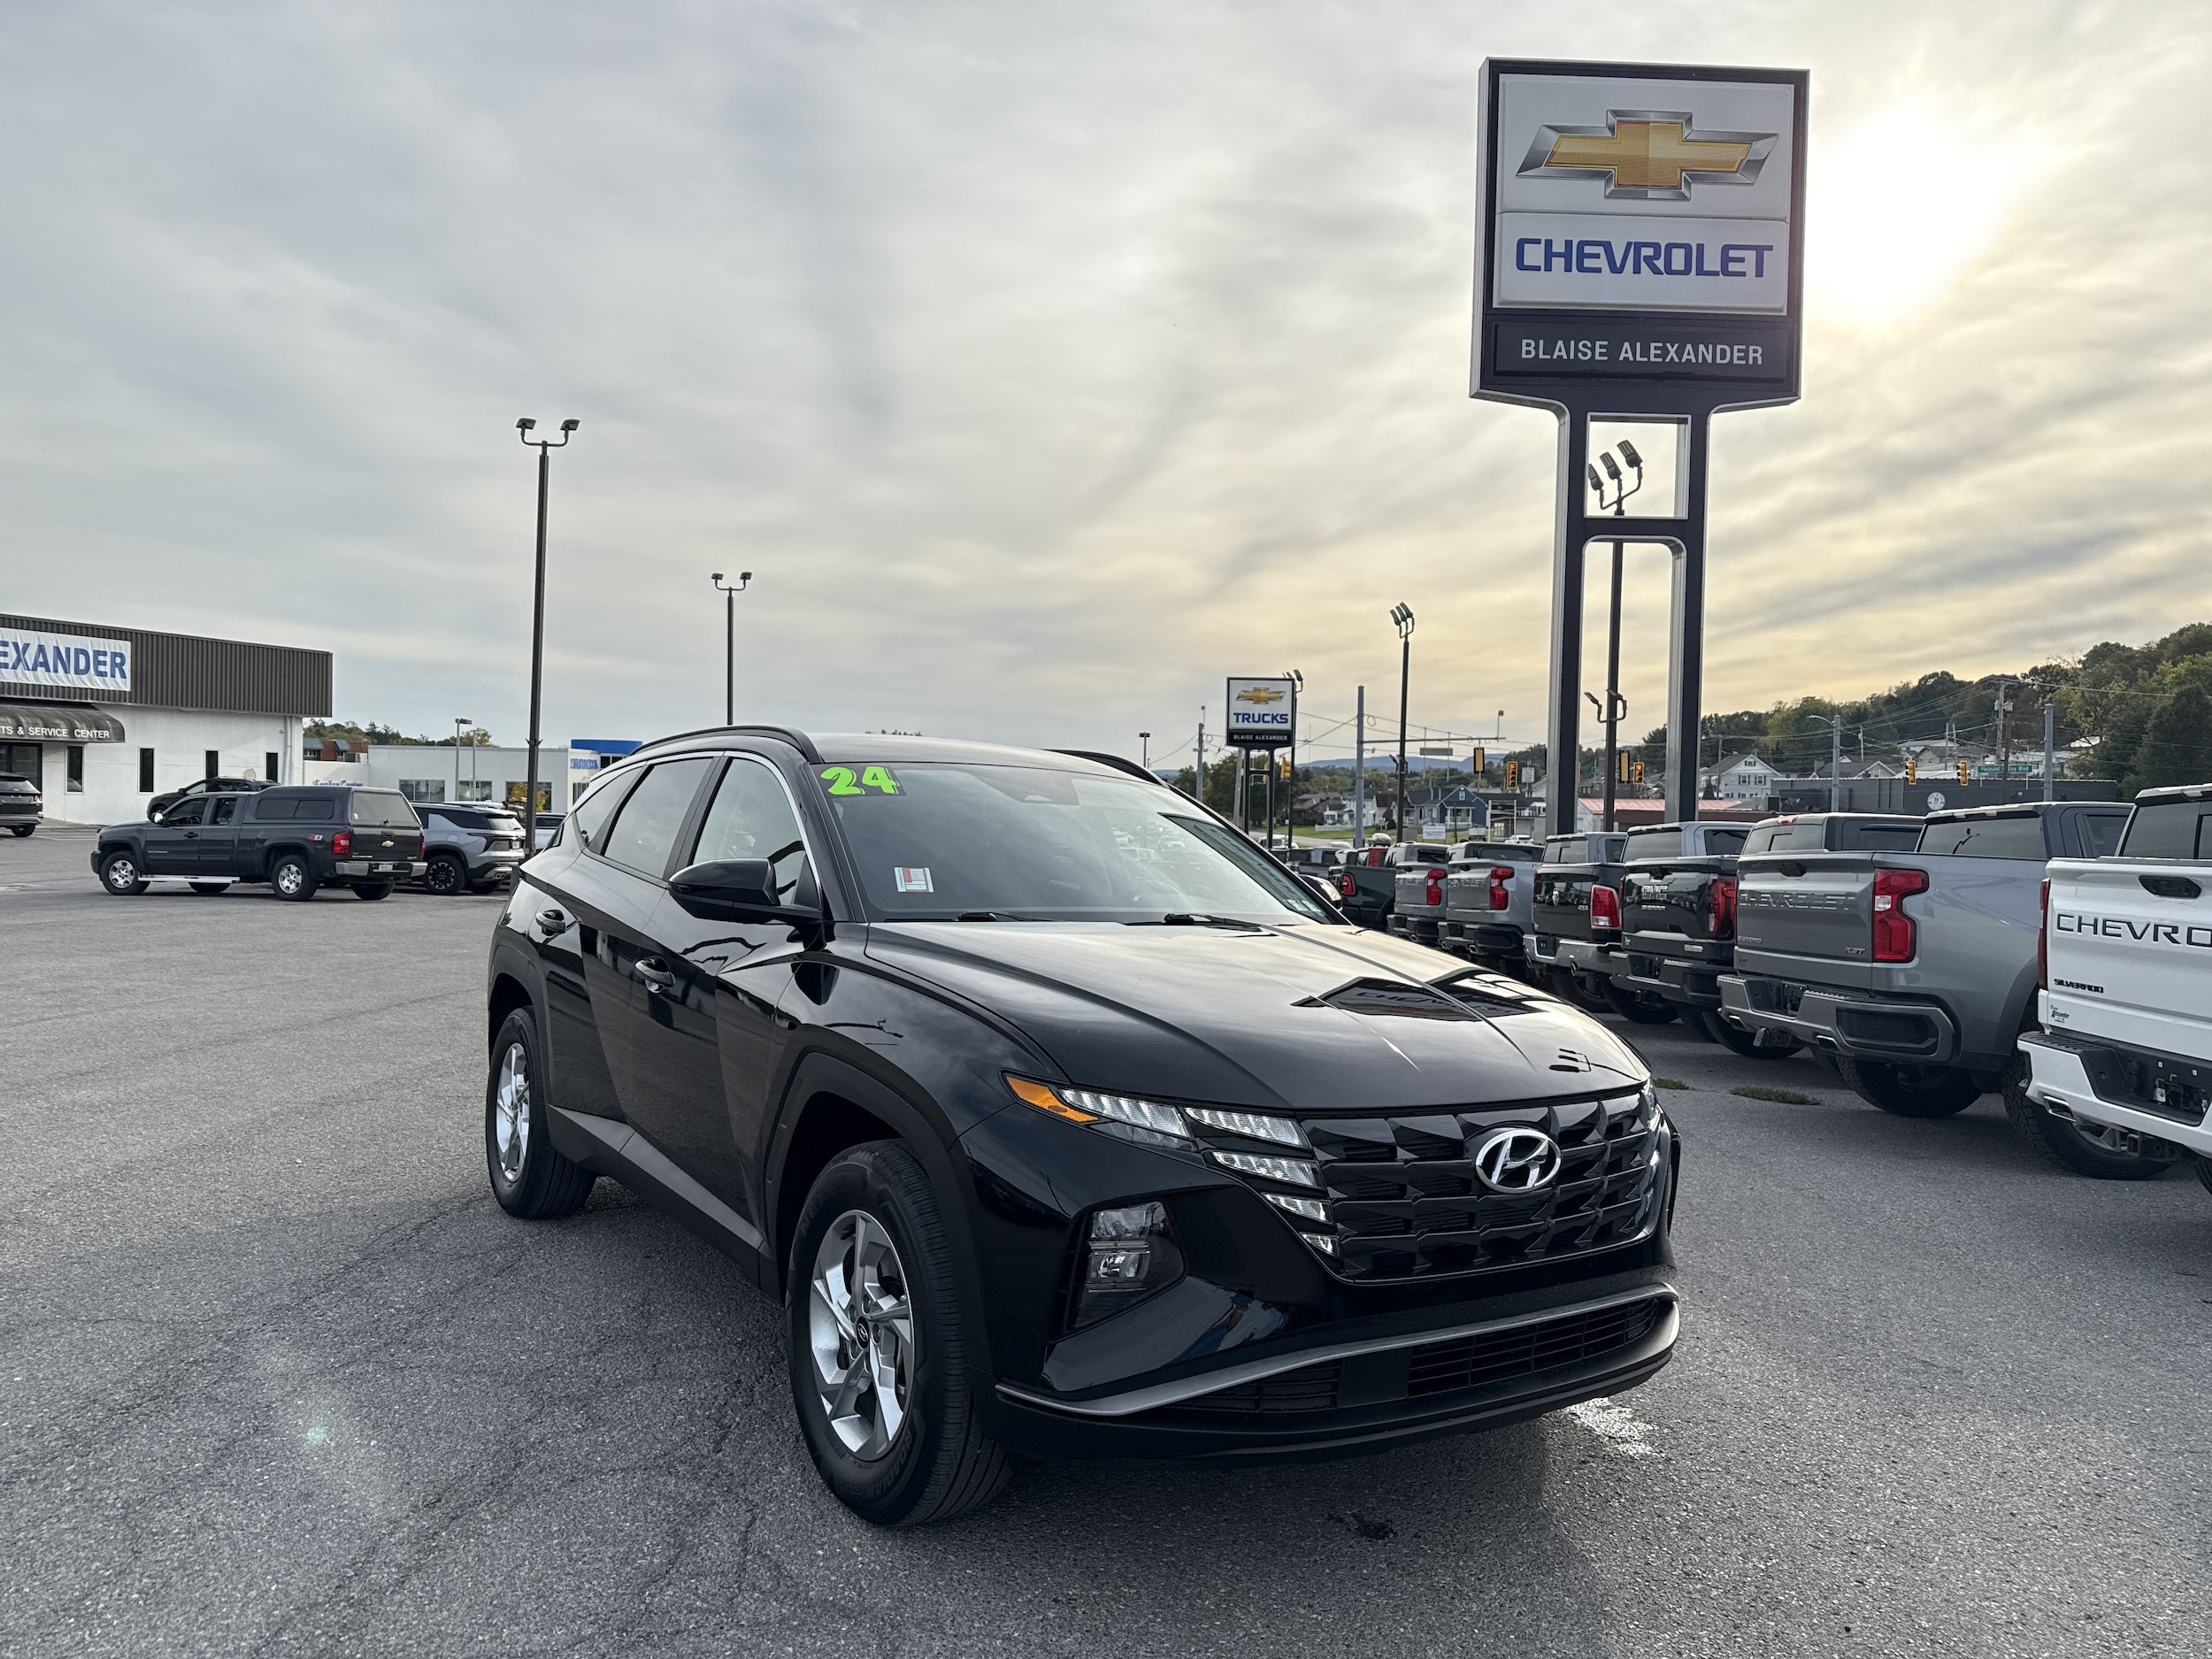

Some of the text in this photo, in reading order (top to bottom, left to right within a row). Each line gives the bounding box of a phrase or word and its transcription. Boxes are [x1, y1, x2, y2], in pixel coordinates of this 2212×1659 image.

[1516, 237, 1773, 278] CHEVROLET
[1520, 338, 1763, 365] BLAISE ALEXANDER
[0, 640, 127, 680] EXANDER
[1233, 712, 1288, 724] TRUCKS
[17, 726, 25, 735] &
[28, 726, 68, 737] SERVICE
[74, 729, 110, 739] CENTER
[820, 765, 901, 795] 24
[1641, 885, 1668, 900] GMC
[2056, 913, 2212, 948] CHEVRO
[2054, 978, 2104, 994] SILVERADO
